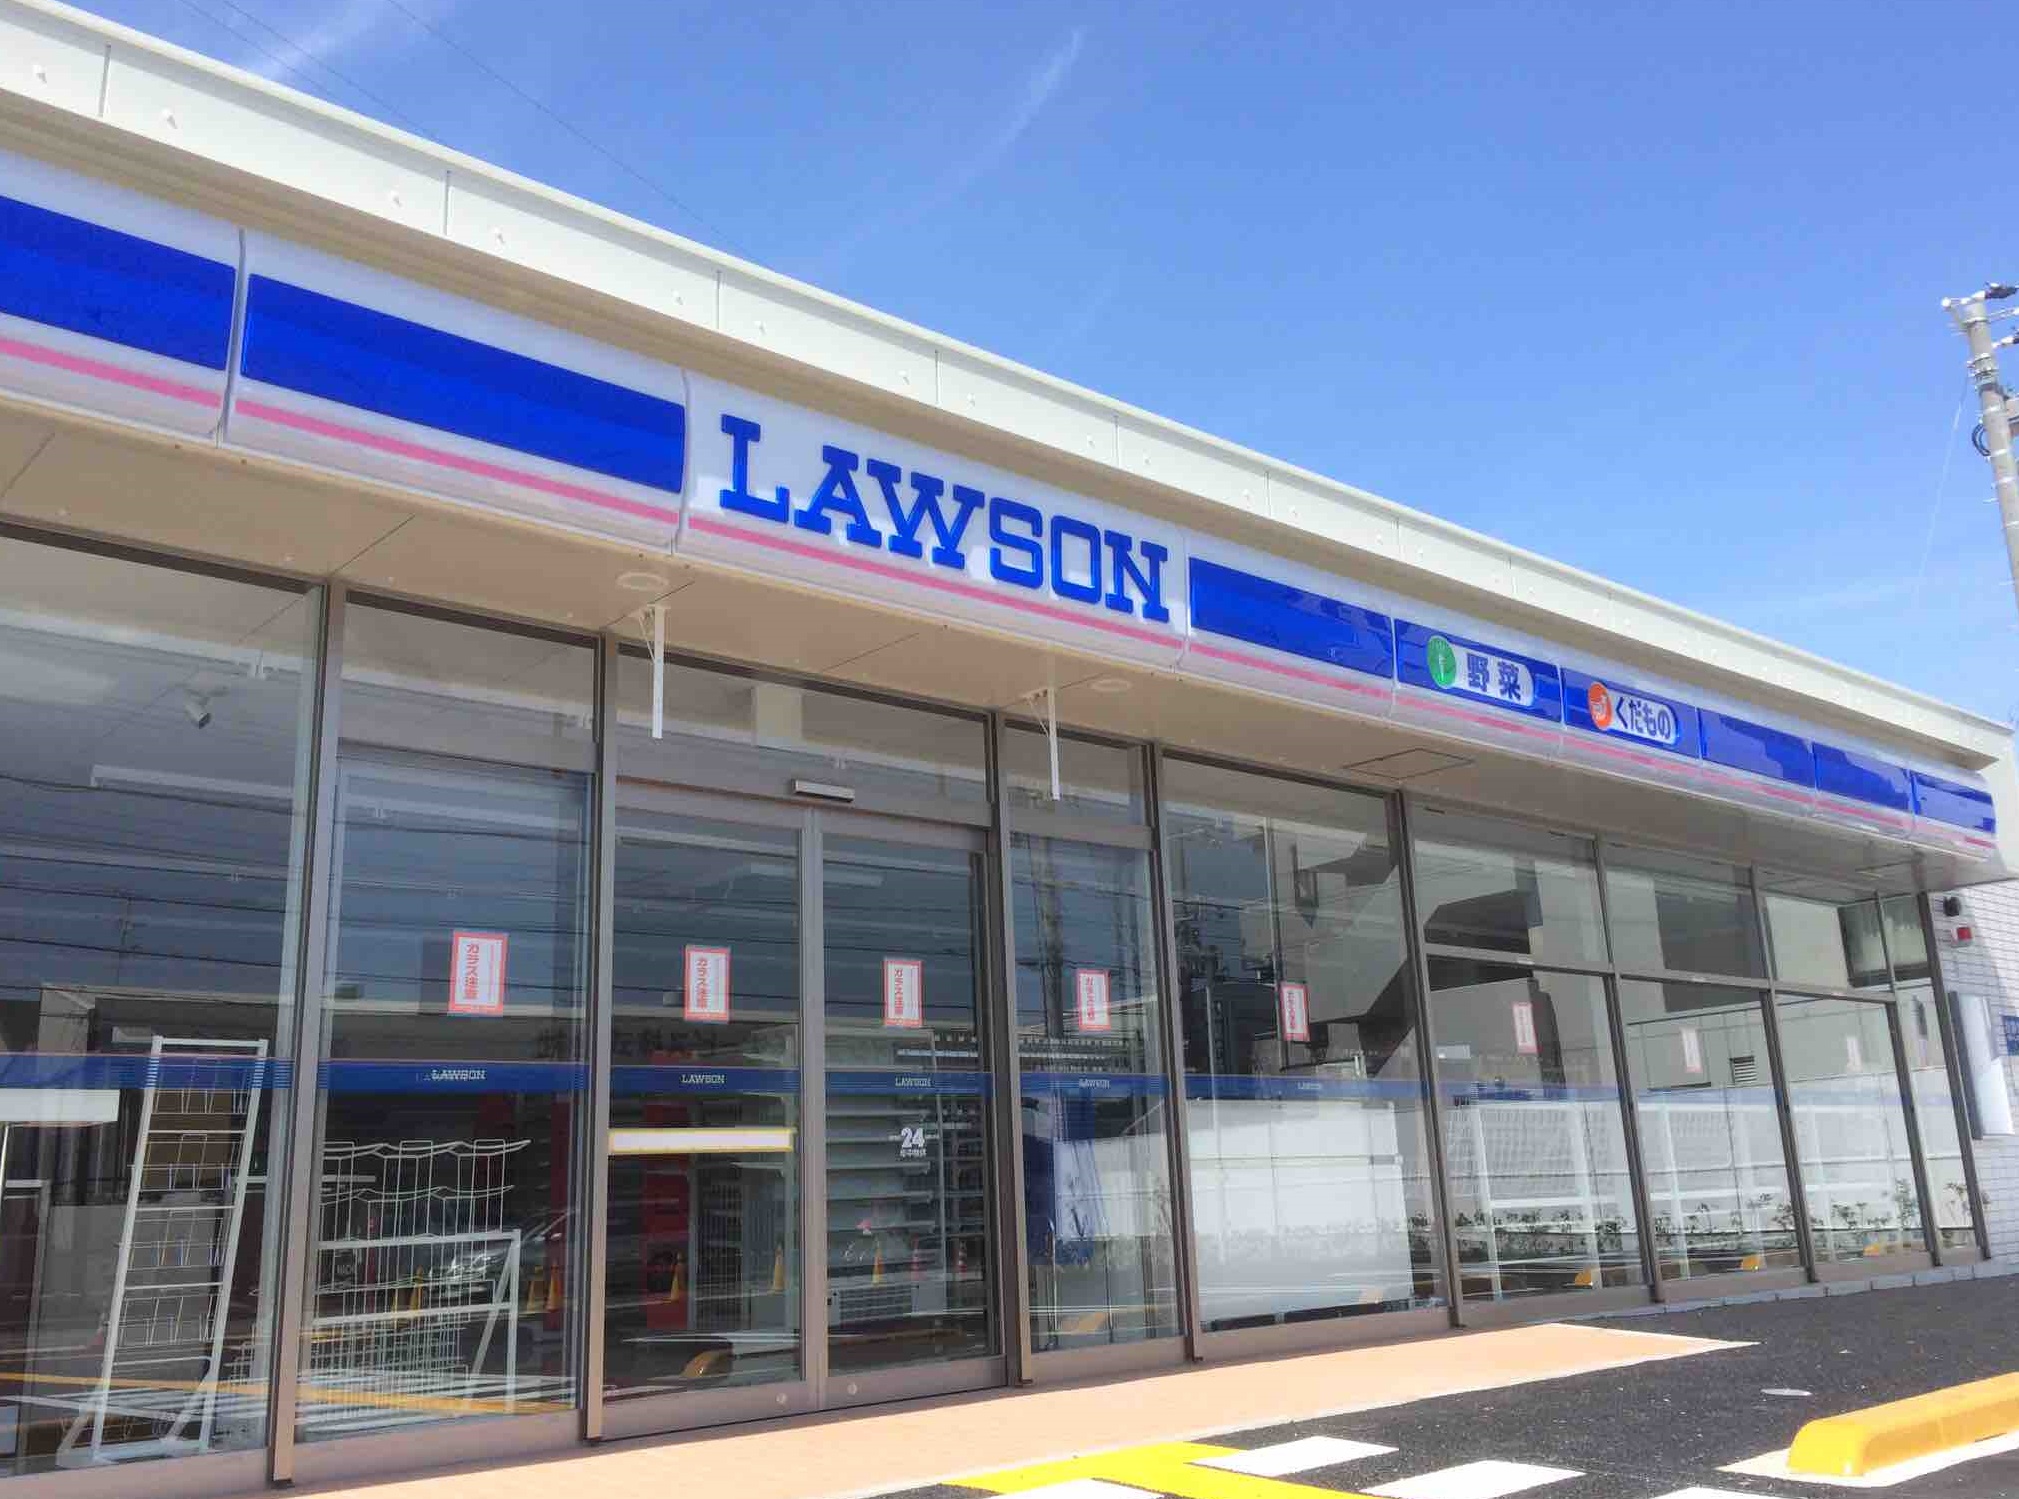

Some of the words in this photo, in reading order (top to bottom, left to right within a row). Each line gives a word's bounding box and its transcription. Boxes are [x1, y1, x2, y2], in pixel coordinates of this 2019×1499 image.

[720, 414, 1168, 623] LAWSON
[1466, 652, 1522, 701] 野菜
[1615, 696, 1671, 740] くだもの
[431, 1069, 487, 1081] LAWSON
[680, 1074, 726, 1084] LAWSON
[901, 1127, 925, 1148] 24
